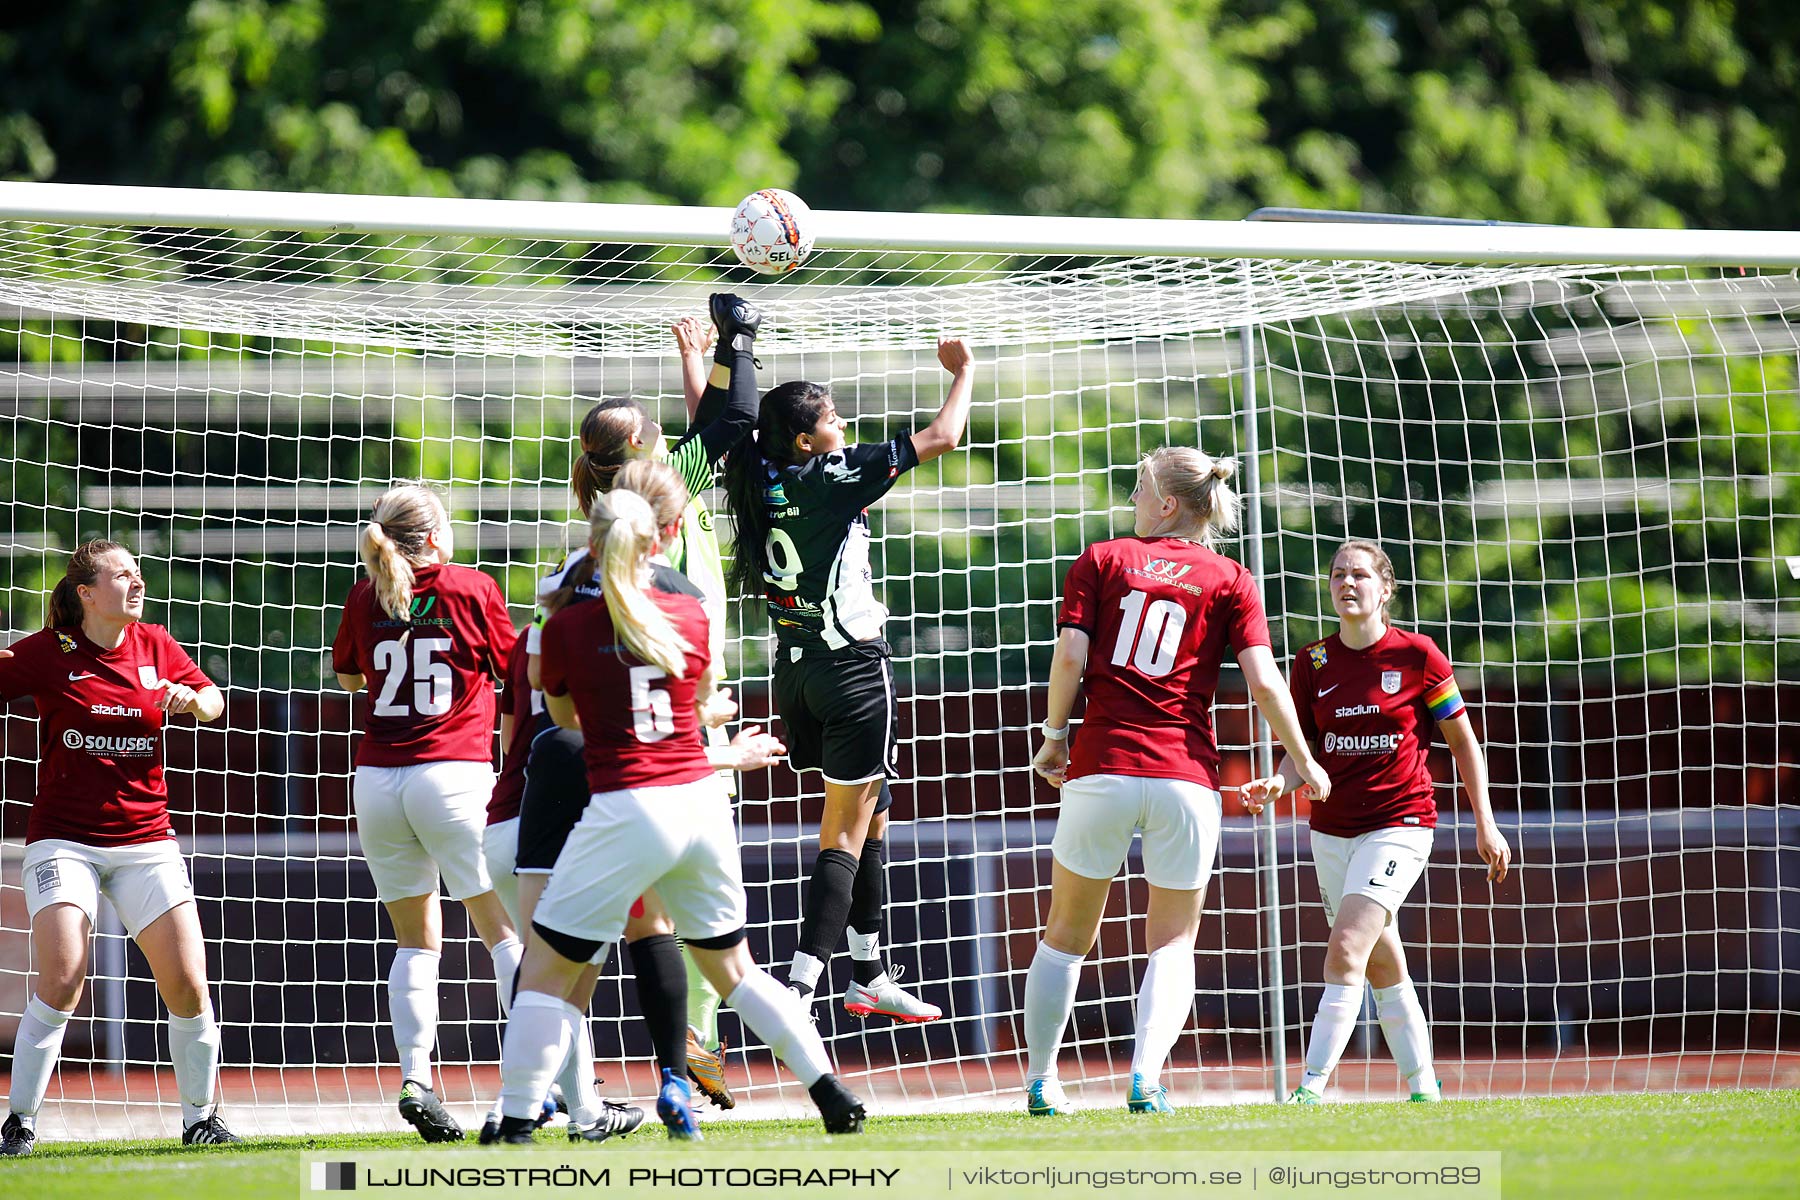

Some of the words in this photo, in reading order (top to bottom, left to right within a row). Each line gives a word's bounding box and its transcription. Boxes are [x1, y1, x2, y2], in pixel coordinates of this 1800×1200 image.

[786, 506, 800, 516] Bil
[763, 527, 804, 591] 9
[1111, 589, 1187, 677] 10
[373, 637, 453, 717] 25
[91, 703, 142, 718] stadium
[629, 664, 675, 744] 5
[1335, 704, 1380, 718] stadium
[1384, 860, 1398, 877] 8
